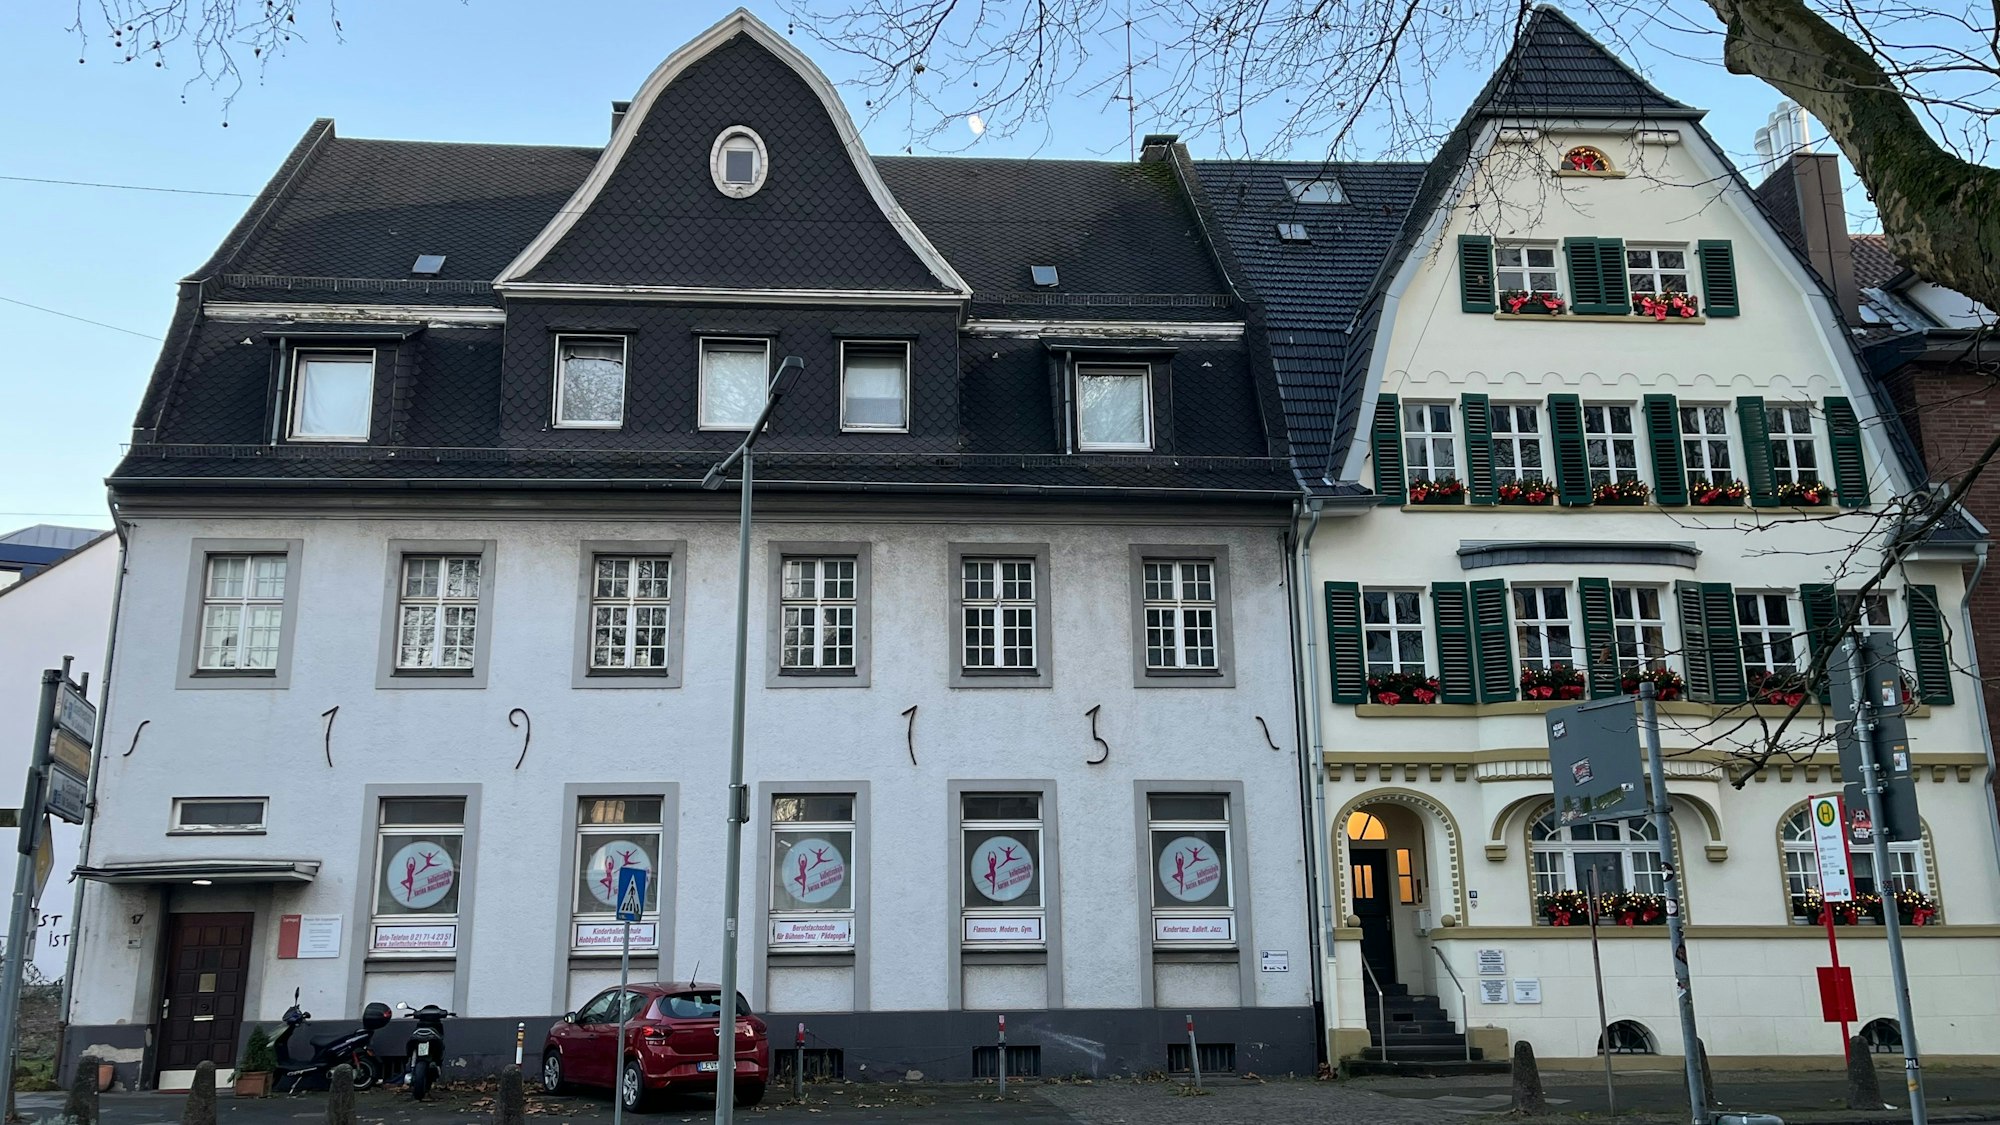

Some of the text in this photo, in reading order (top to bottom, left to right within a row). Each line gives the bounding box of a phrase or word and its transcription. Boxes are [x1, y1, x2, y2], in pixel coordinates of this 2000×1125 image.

[132, 914, 143, 925] 17
[792, 924, 836, 932] Berufsfachschule
[379, 933, 410, 941] Info-Telefon
[777, 932, 785, 940] für
[785, 932, 817, 940] Bühnen-Tanz
[821, 931, 847, 941] Pädagogik
